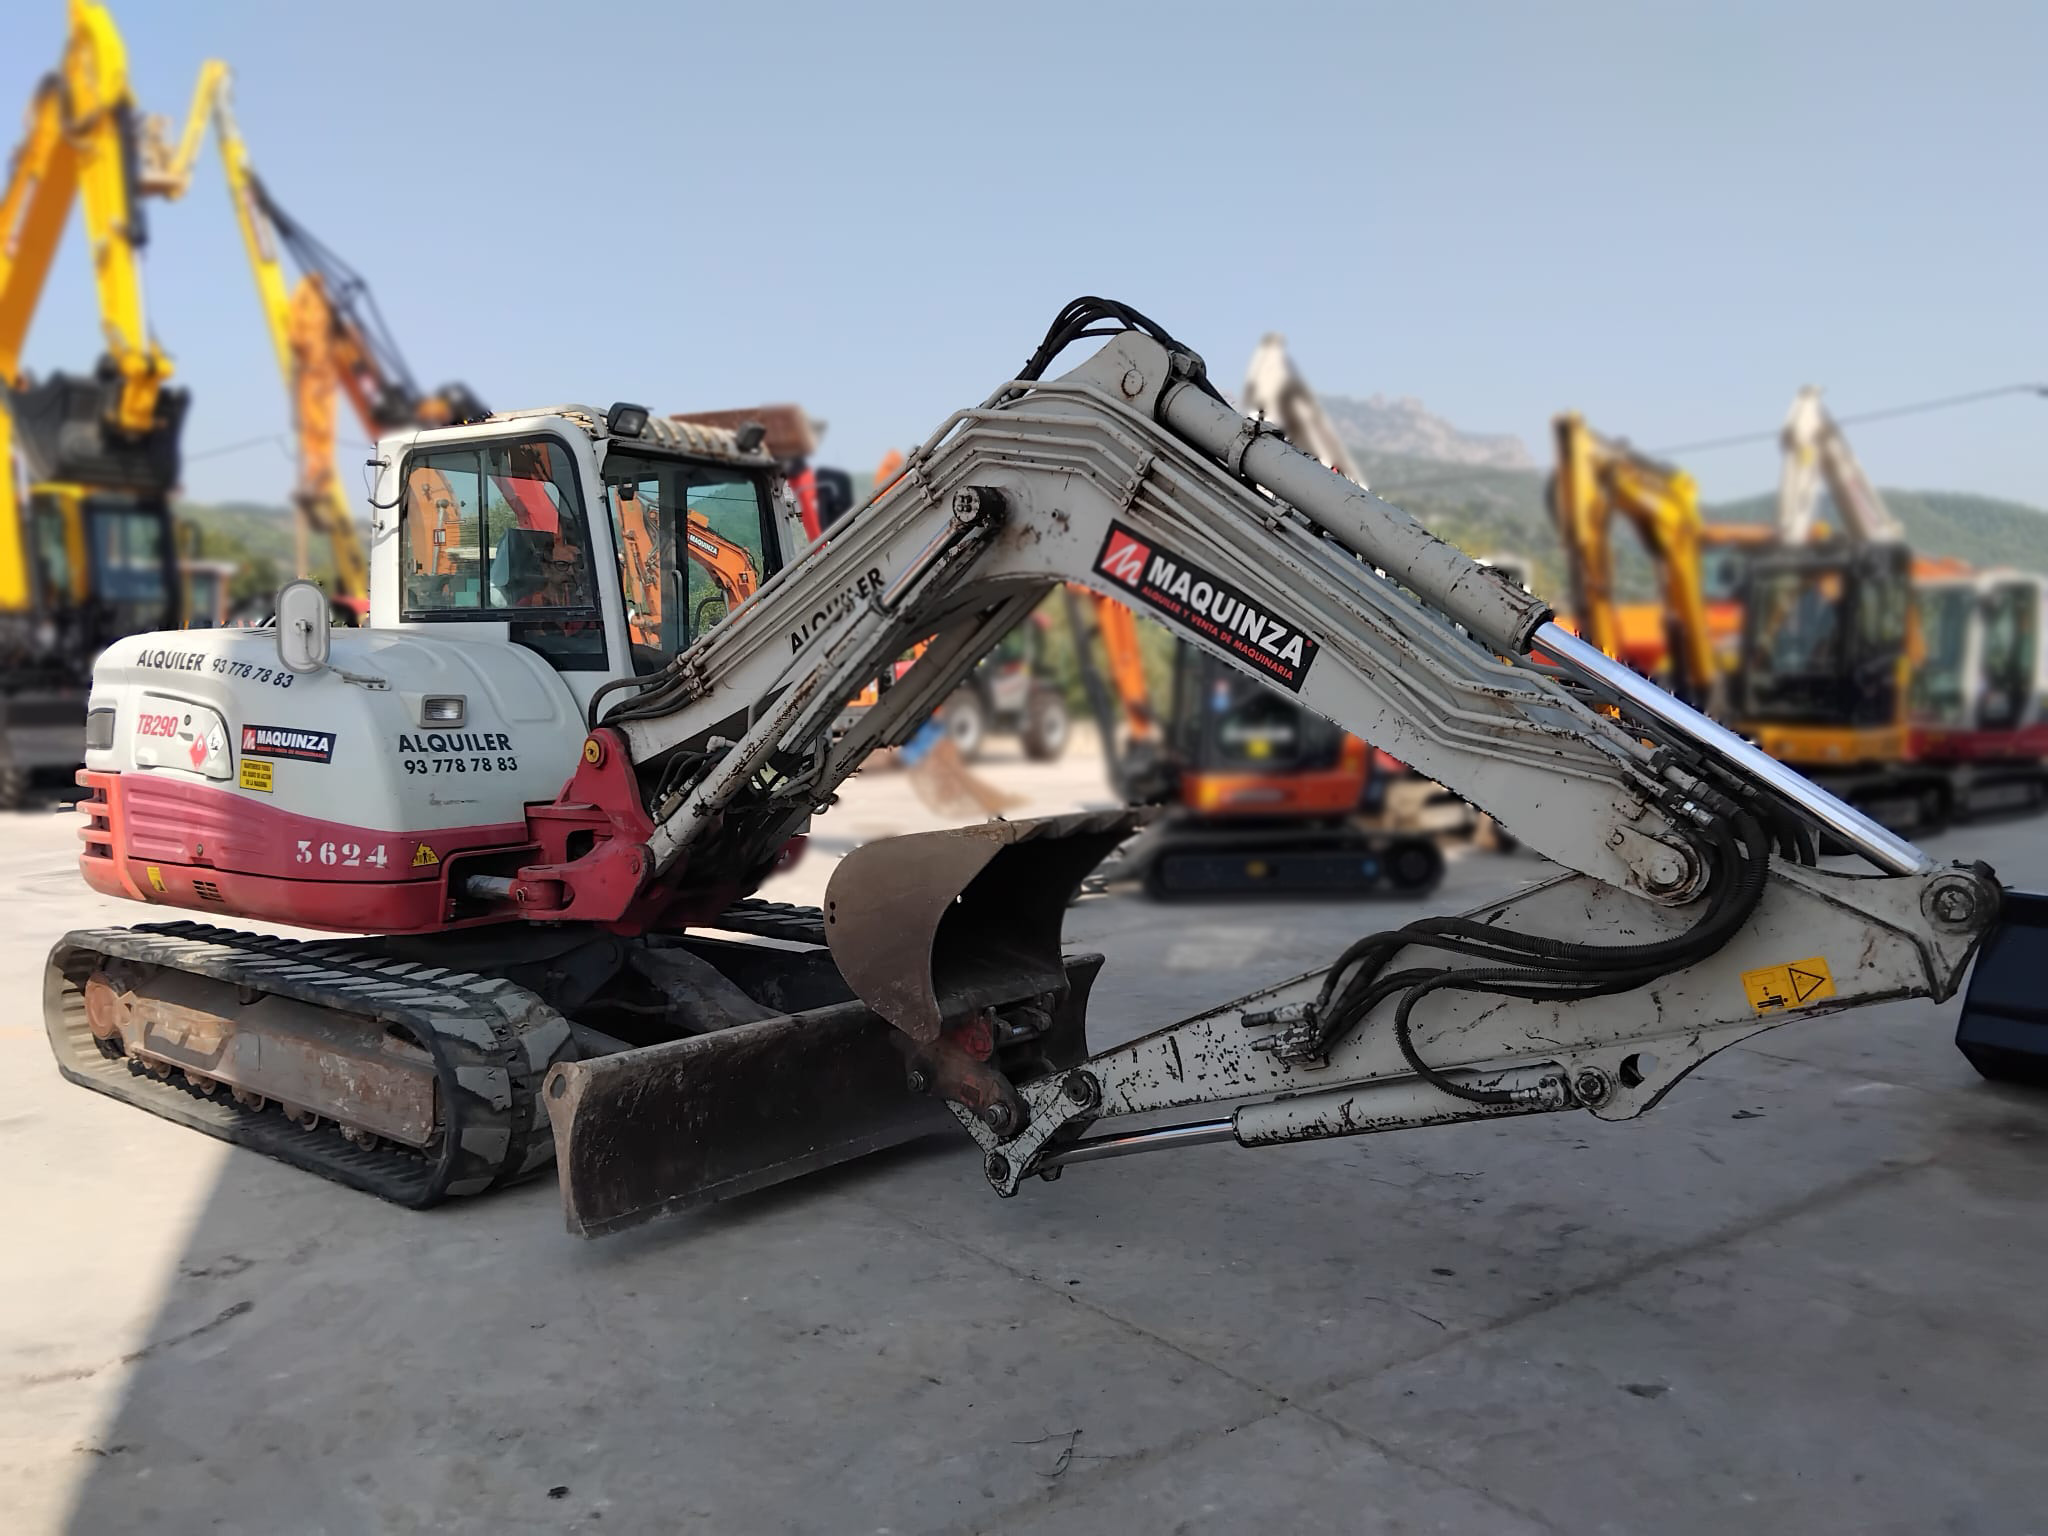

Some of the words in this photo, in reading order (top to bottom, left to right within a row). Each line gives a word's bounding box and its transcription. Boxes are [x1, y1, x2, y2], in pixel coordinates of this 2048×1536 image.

[1147, 555, 1304, 668] MAQUINZA
[1141, 586, 1181, 613] ALQUILER
[1183, 609, 1190, 619] Y
[1191, 615, 1218, 636] VENTA
[1220, 632, 1232, 644] DE
[1233, 639, 1294, 681] MAQUINARIA
[136, 649, 206, 672] ALQUILER
[212, 658, 227, 674] 93
[227, 661, 253, 678] 778
[252, 667, 273, 683] 78
[273, 672, 294, 688] 83
[137, 714, 179, 738] TB290
[256, 730, 329, 752] MAQUINZA
[398, 733, 513, 753] ALQUILER
[404, 759, 428, 774] 93
[432, 758, 466, 773] 778
[470, 757, 492, 772] 78
[497, 756, 518, 771] 83
[296, 840, 388, 868] 3624
